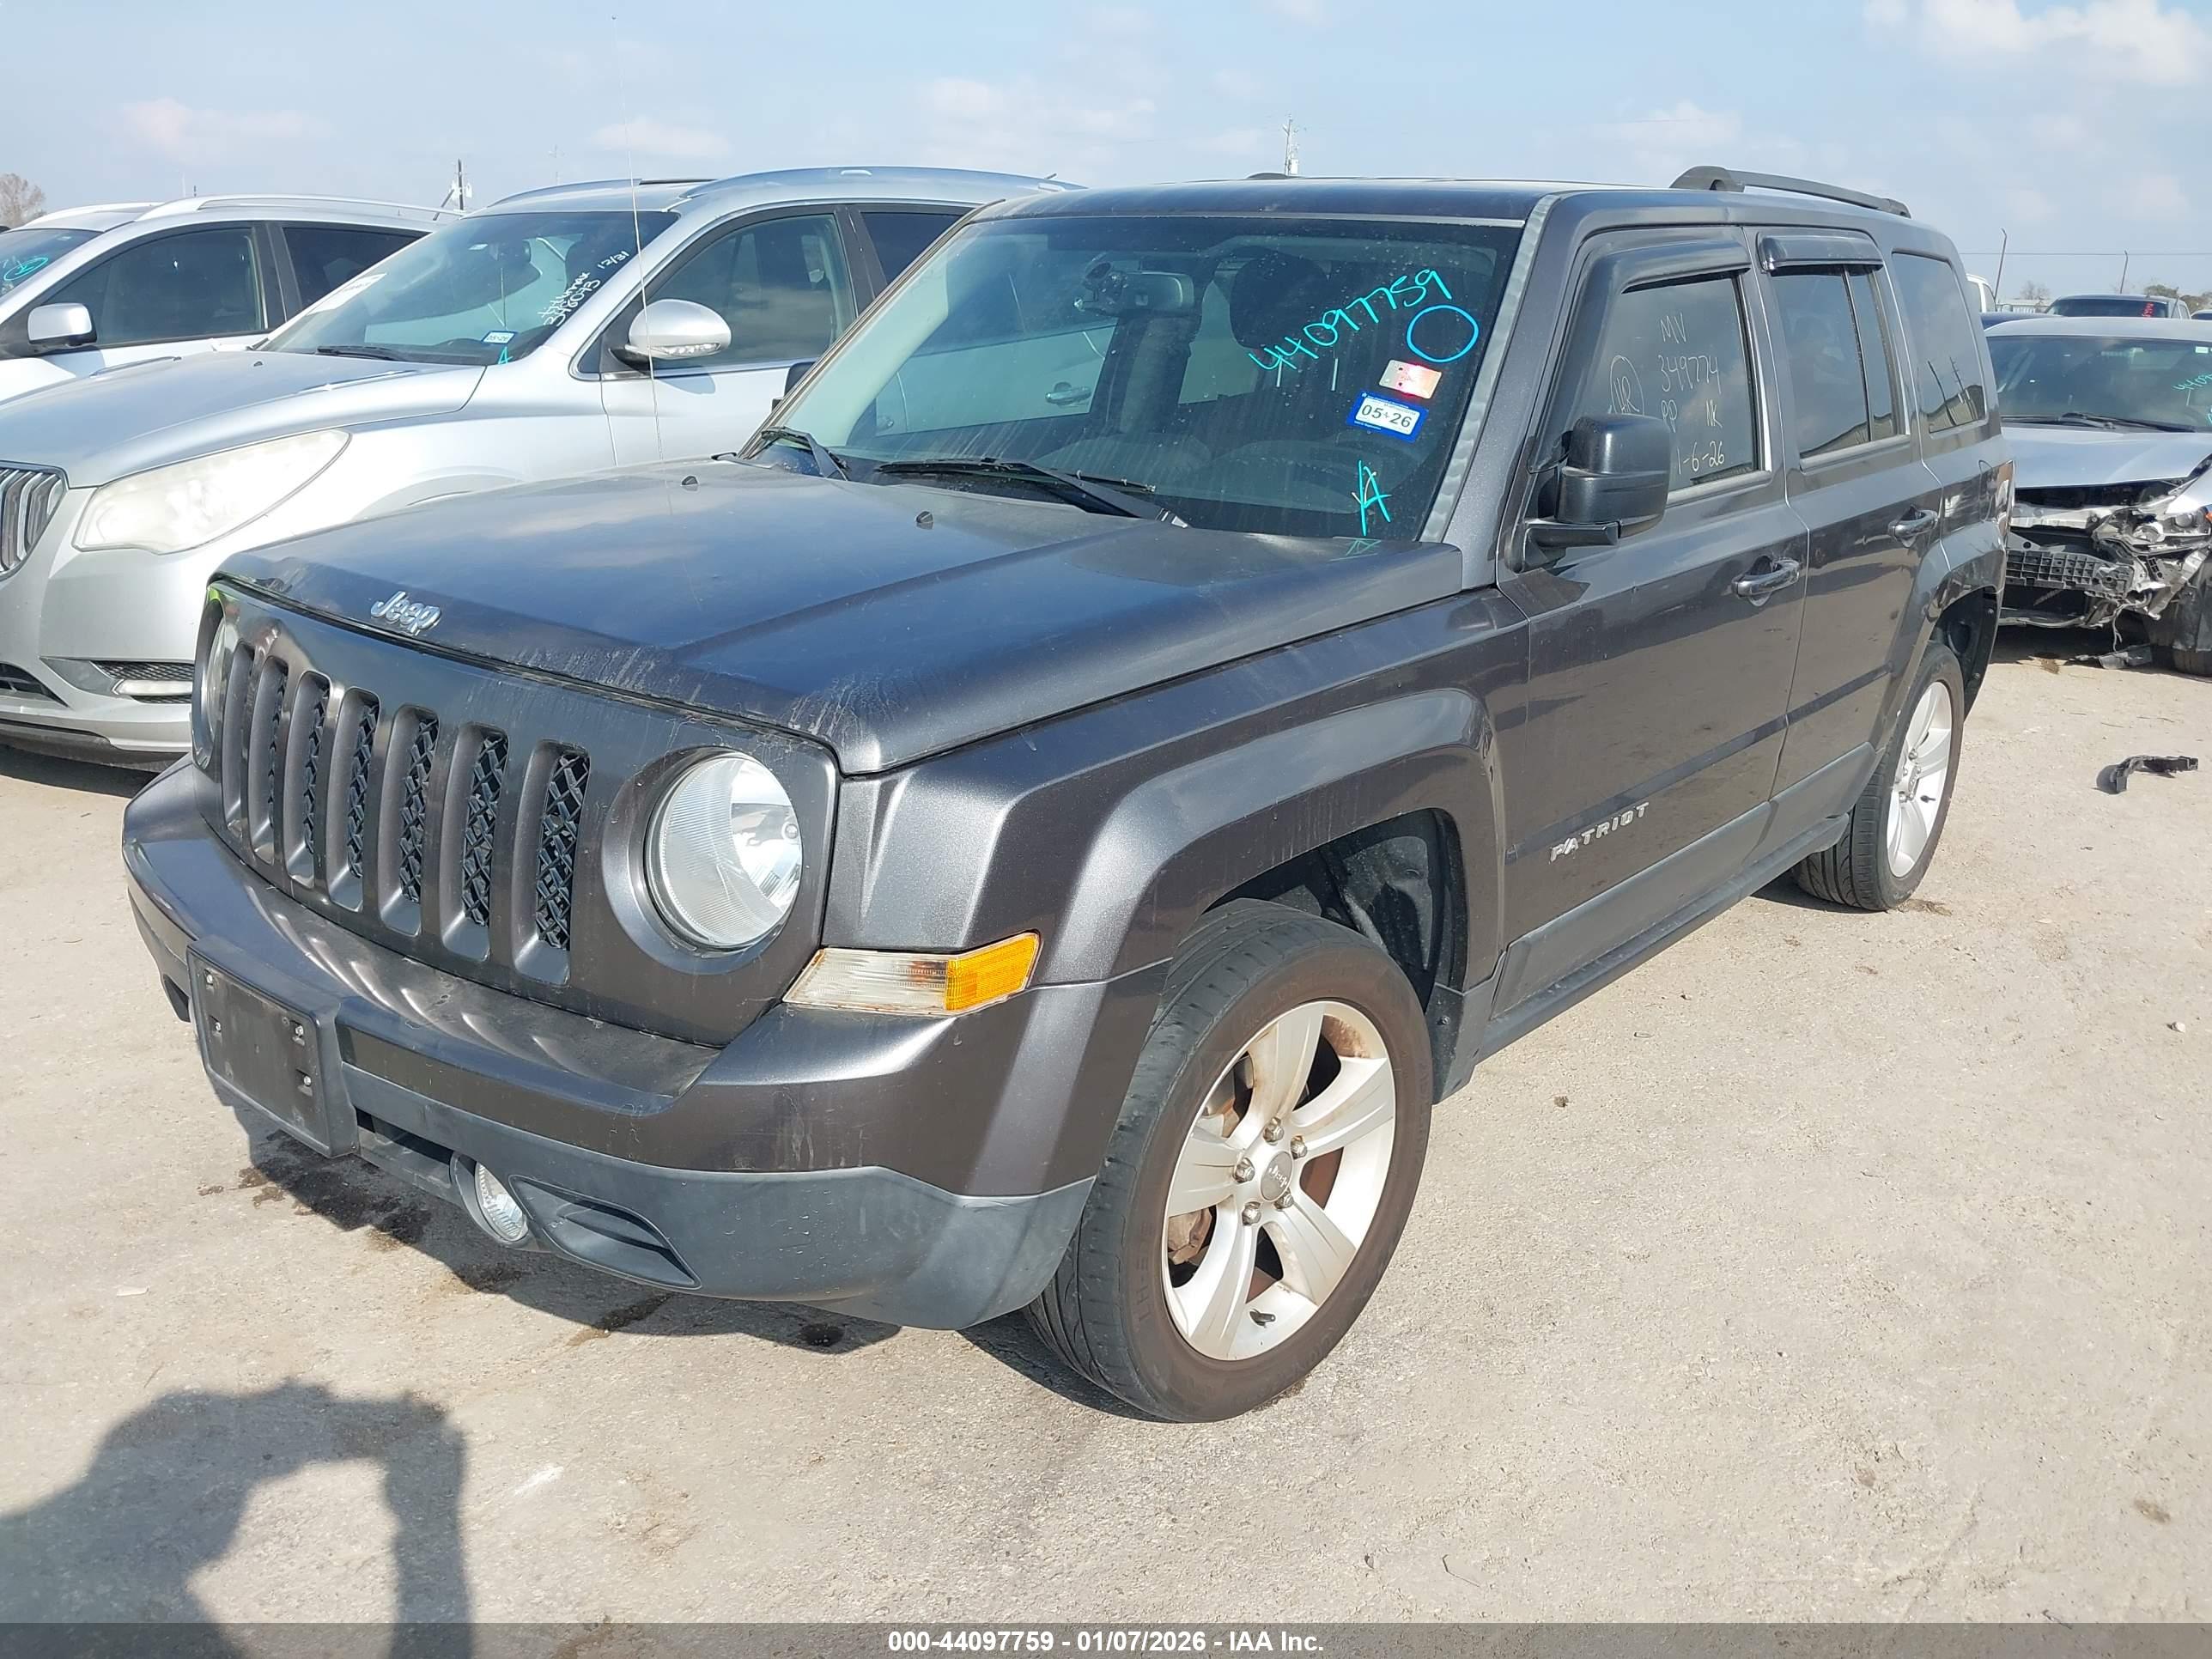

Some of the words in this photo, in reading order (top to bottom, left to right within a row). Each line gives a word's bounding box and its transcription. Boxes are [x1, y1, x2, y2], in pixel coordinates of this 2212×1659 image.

[1249, 270, 1452, 370] 44097759
[1658, 355, 1722, 395] 349774
[1676, 441, 1725, 475] 1-6-26
[371, 591, 441, 635] Jeep
[1550, 802, 1650, 862] PATRIOT
